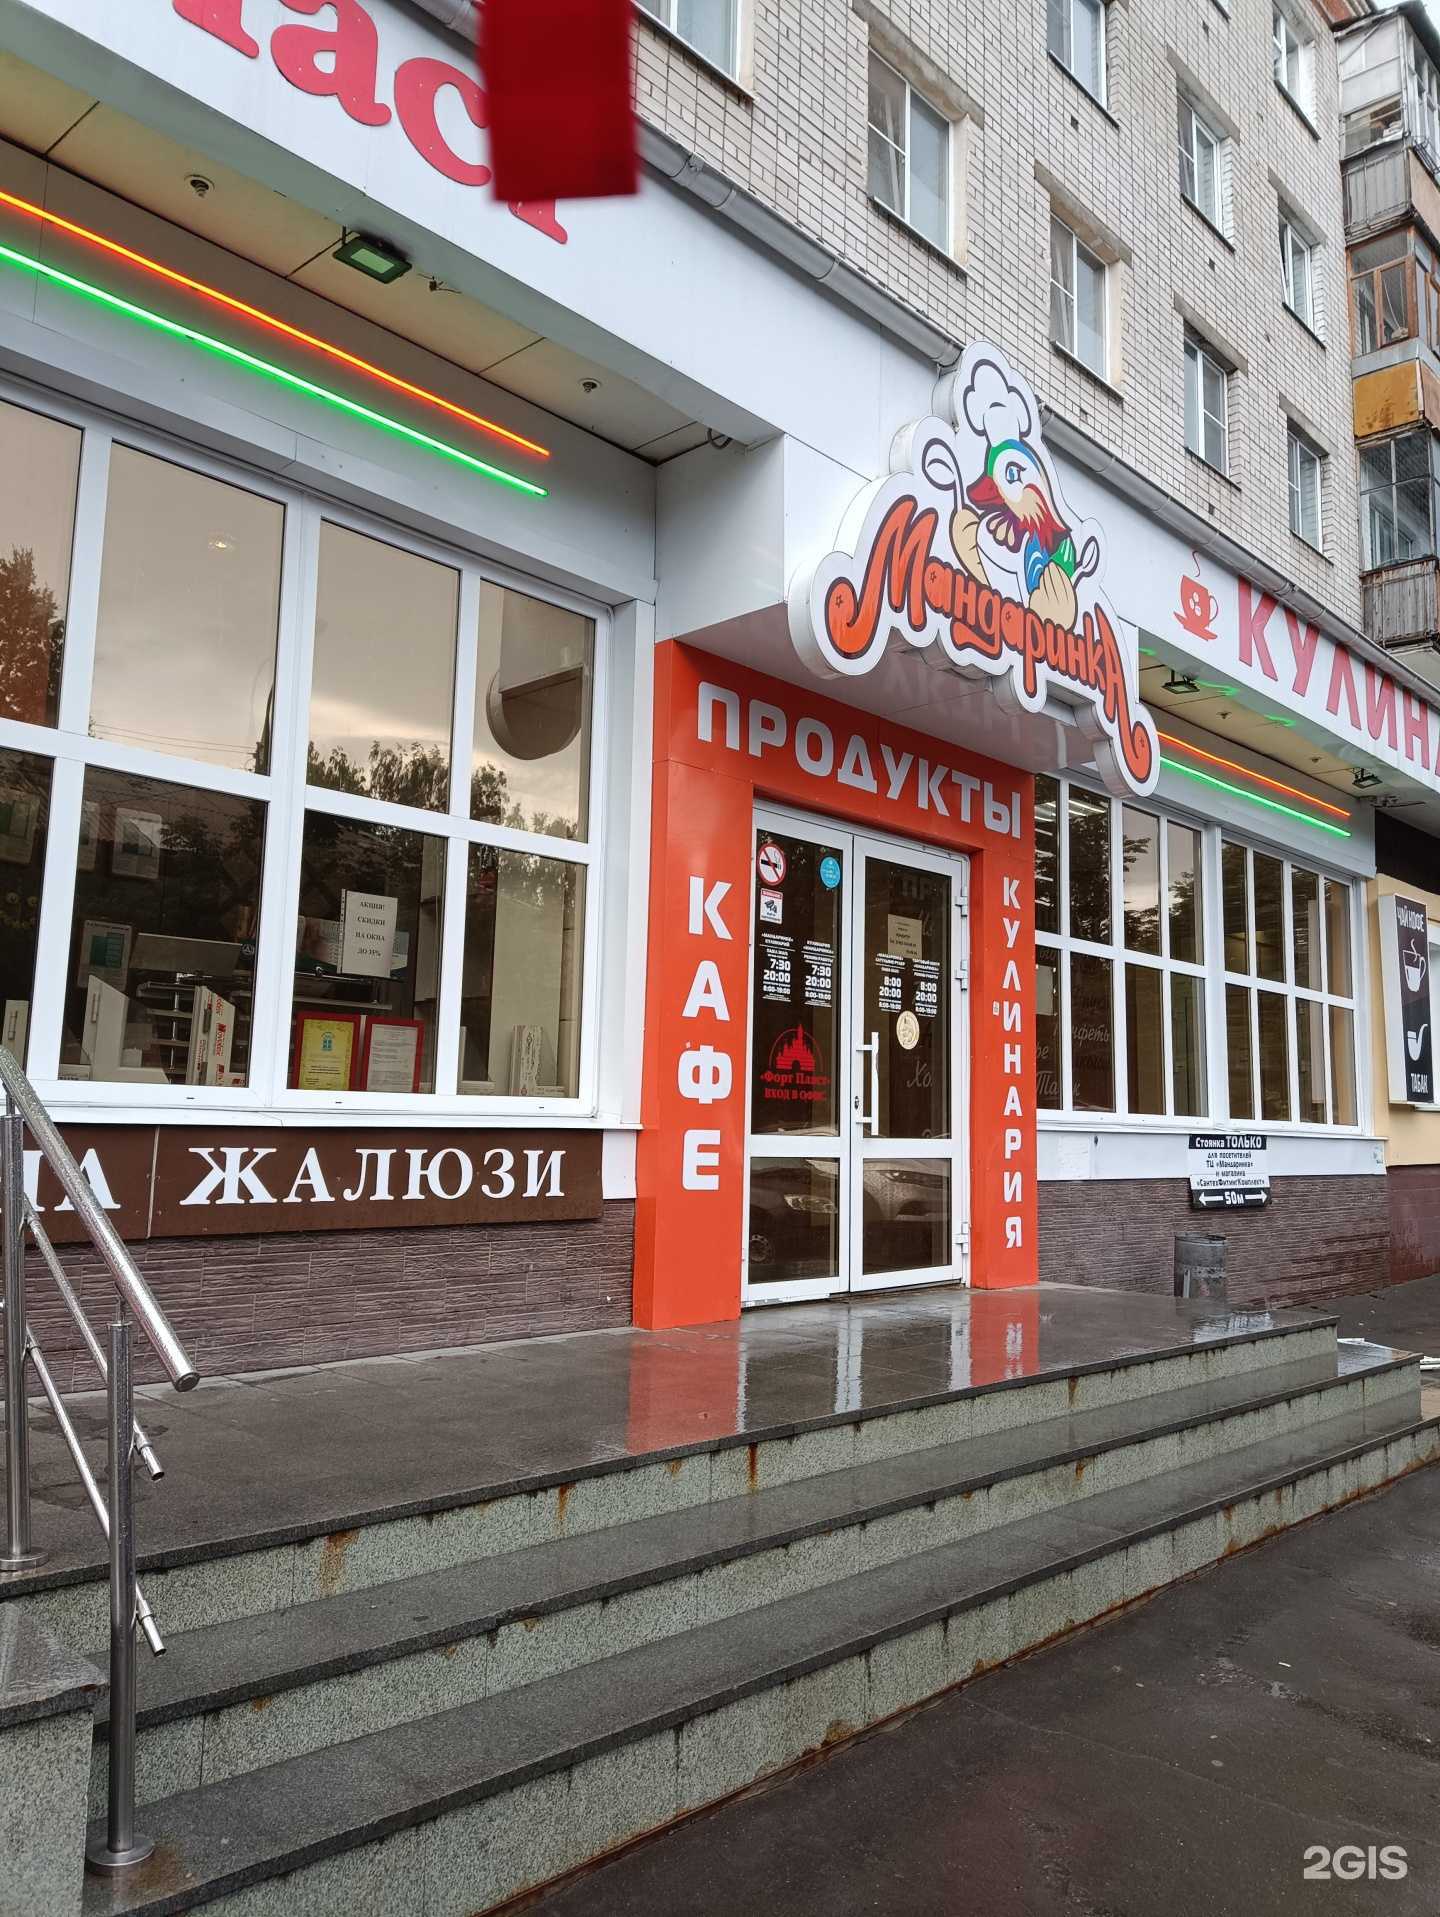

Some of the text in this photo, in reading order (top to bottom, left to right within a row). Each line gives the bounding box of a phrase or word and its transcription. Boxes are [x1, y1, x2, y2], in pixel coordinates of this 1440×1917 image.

[1238, 574, 1440, 777] КУЛИН
[697, 681, 1021, 839] ПРОДУКТЫ
[770, 959, 791, 971] 7:30
[811, 965, 831, 977] 7:30
[763, 969, 791, 983] 20:00
[805, 975, 831, 988] 20:00
[884, 976, 902, 988] 8:00
[879, 986, 902, 998] 20:00
[920, 981, 937, 992] 8:00
[915, 991, 937, 1003] 20:00
[677, 875, 734, 1191] КАФЕ
[1002, 876, 1023, 1249] КУЛИНАРИЯ
[1410, 1072, 1429, 1094] ТАБАК
[1195, 1135, 1263, 1149] Стоянка ТОЛЬКО
[179, 1147, 567, 1206] ЖАЛЮЗИ
[1224, 1190, 1245, 1205] 50м
